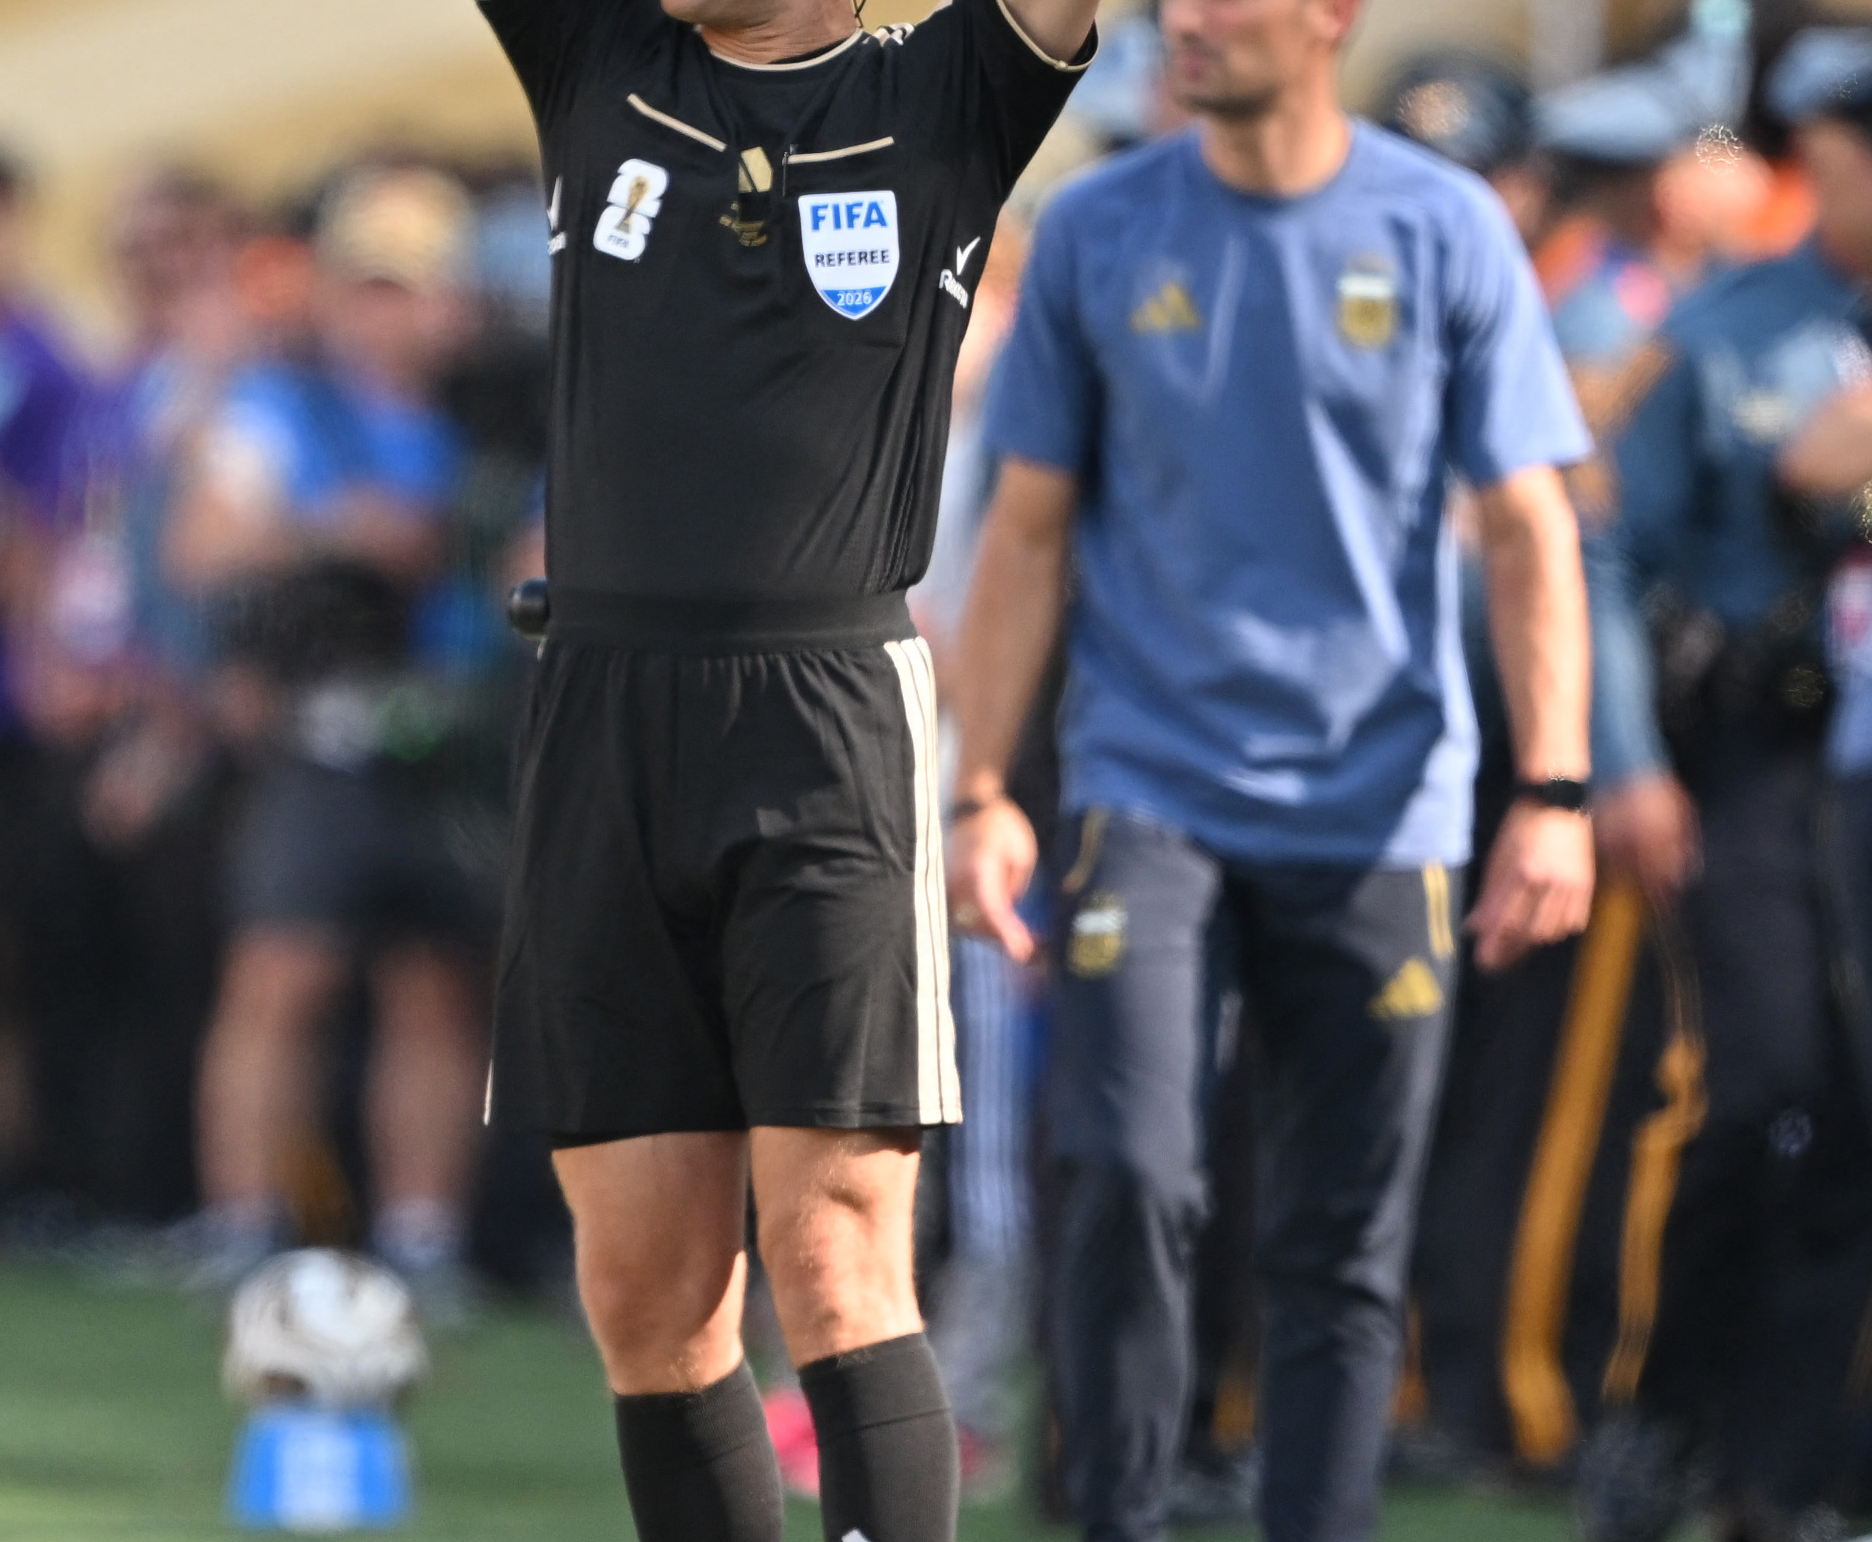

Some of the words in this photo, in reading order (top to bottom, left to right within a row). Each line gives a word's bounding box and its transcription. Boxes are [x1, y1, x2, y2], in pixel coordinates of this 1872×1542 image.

[809, 200, 889, 232] FIFA
[814, 248, 891, 269] REFEREE
[835, 291, 873, 306] 2026
